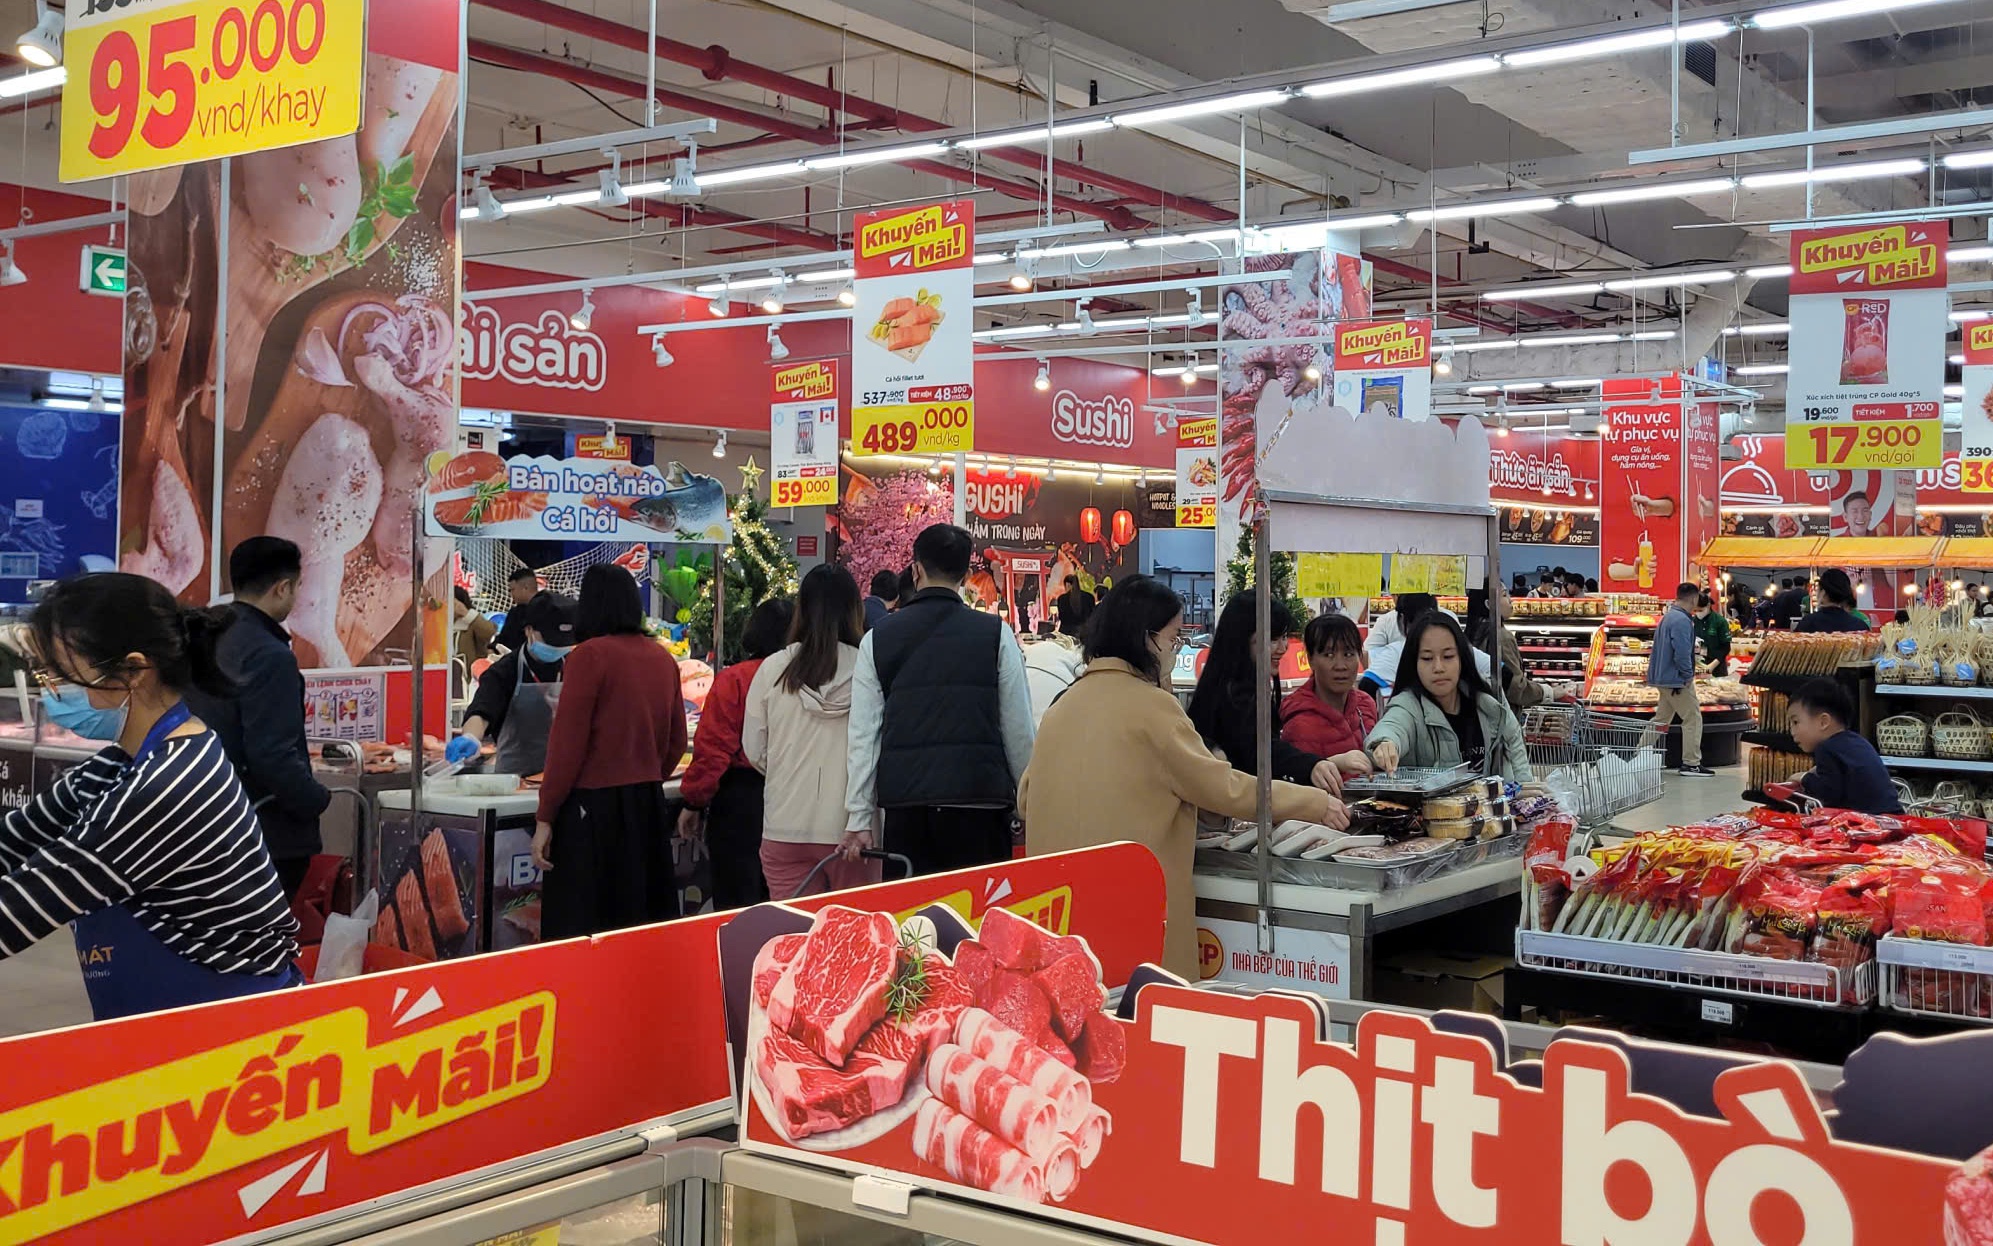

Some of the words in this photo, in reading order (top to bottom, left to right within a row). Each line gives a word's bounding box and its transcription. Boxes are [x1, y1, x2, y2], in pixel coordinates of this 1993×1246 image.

[88, 0, 325, 159] 95.000
[197, 82, 326, 138] vnd/khay
[866, 212, 936, 250] Khuyến
[919, 227, 961, 264] Mãi!
[1805, 232, 1899, 265] Khuyến
[1875, 246, 1931, 282] Mãi!
[507, 320, 598, 381] sản
[1345, 327, 1402, 350] Khuyến
[1387, 337, 1421, 363] Mãi!
[778, 366, 818, 388] Khuyến
[807, 375, 831, 396] Mãi!
[1056, 397, 1130, 441] Sushi
[1612, 411, 1640, 425] Khu
[1643, 411, 1671, 426] vực
[1803, 407, 1839, 421] 19.600
[1904, 402, 1934, 419] 1.700
[862, 406, 969, 454] 489.000
[923, 432, 961, 448] vnd/kg
[1181, 420, 1216, 436] Khuyến
[1604, 428, 1619, 443] tự
[1622, 426, 1658, 443] phục
[1661, 428, 1679, 442] vụ
[1809, 424, 1922, 464] 17.900
[1491, 455, 1526, 485] Thức
[1528, 459, 1544, 487] ăn
[1864, 450, 1915, 465] vnd/gói
[511, 464, 559, 491] Bàn
[564, 466, 620, 499] hoạt
[622, 471, 668, 498] náo
[777, 480, 830, 504] 59.000
[1149, 493, 1170, 502] HOTPOT
[542, 508, 576, 535] Cá
[580, 503, 618, 534] hồi
[1151, 501, 1176, 510] NOODLES
[990, 524, 1021, 540] TRONG
[1022, 523, 1046, 540] NGÀY
[1232, 949, 1251, 972] NHÀ
[1253, 951, 1273, 975] BẾP
[1275, 953, 1295, 979] CỦA
[1298, 955, 1317, 982] THẾ
[1319, 960, 1339, 985] GIỚI
[369, 1003, 545, 1136] Mãi!
[1150, 1006, 1501, 1246] Thịt
[1560, 1060, 1855, 1246] bò
